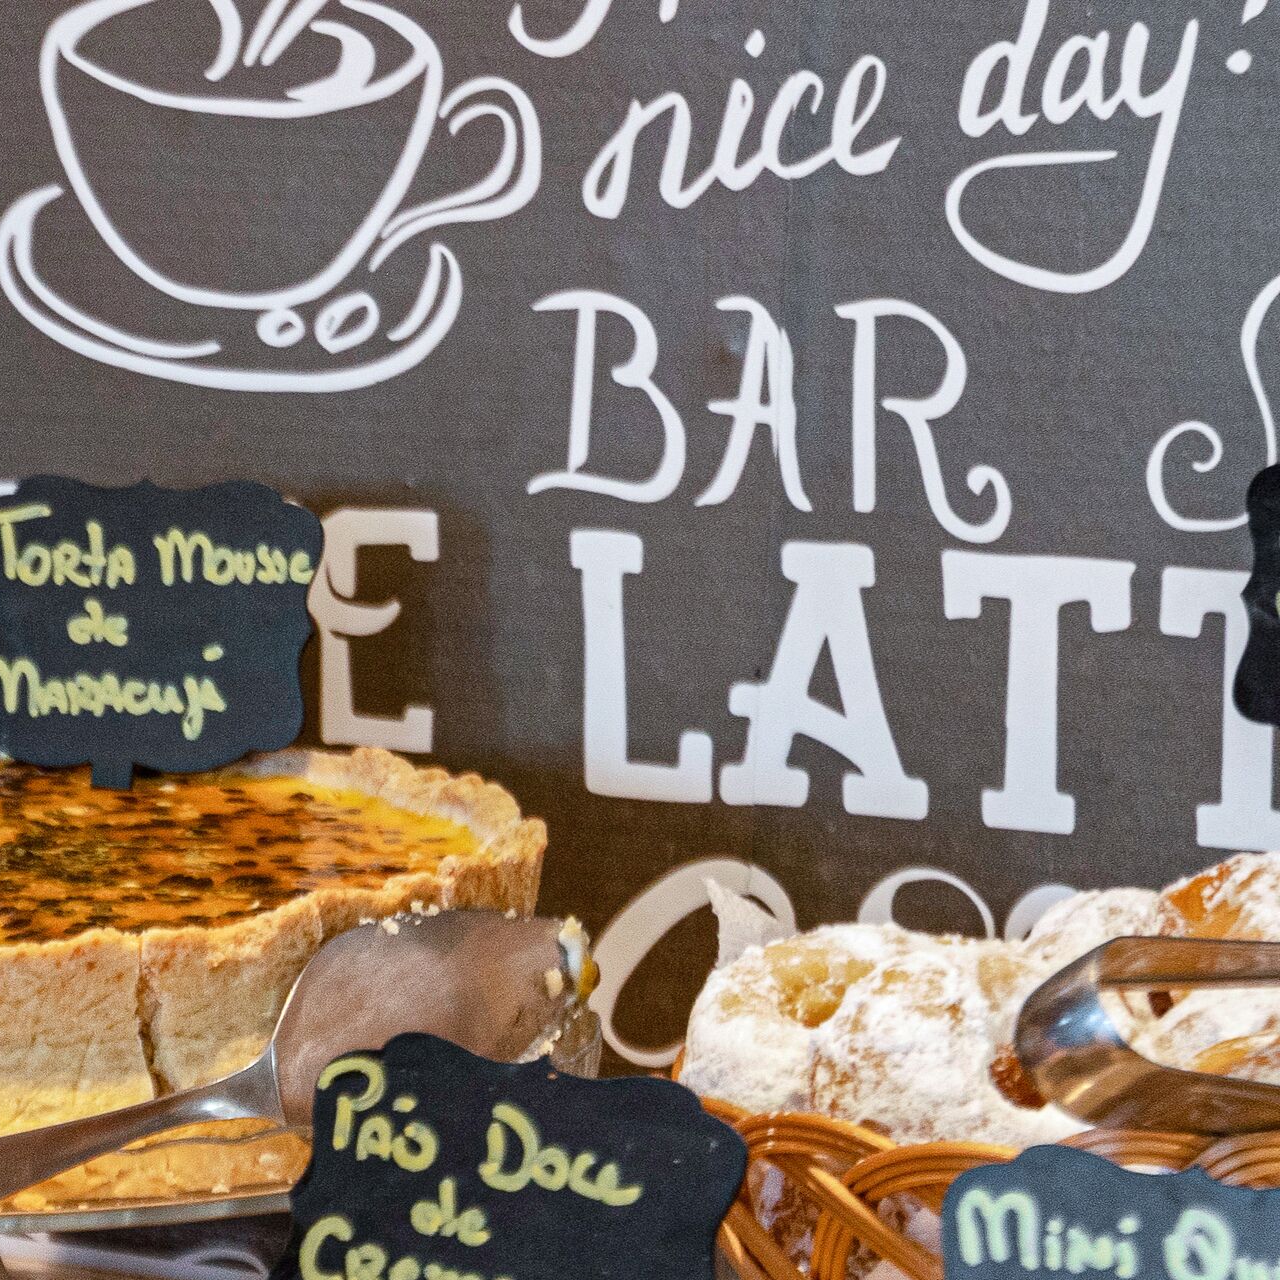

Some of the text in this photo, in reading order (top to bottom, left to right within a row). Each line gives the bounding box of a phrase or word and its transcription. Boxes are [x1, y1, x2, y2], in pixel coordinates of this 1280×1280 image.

[582, 28, 903, 220] nice
[527, 288, 1012, 544] BAR
[66, 597, 130, 648] de
[478, 1102, 644, 1208] Doce
[408, 1176, 492, 1247] de
[955, 1187, 1140, 1280] Mini
